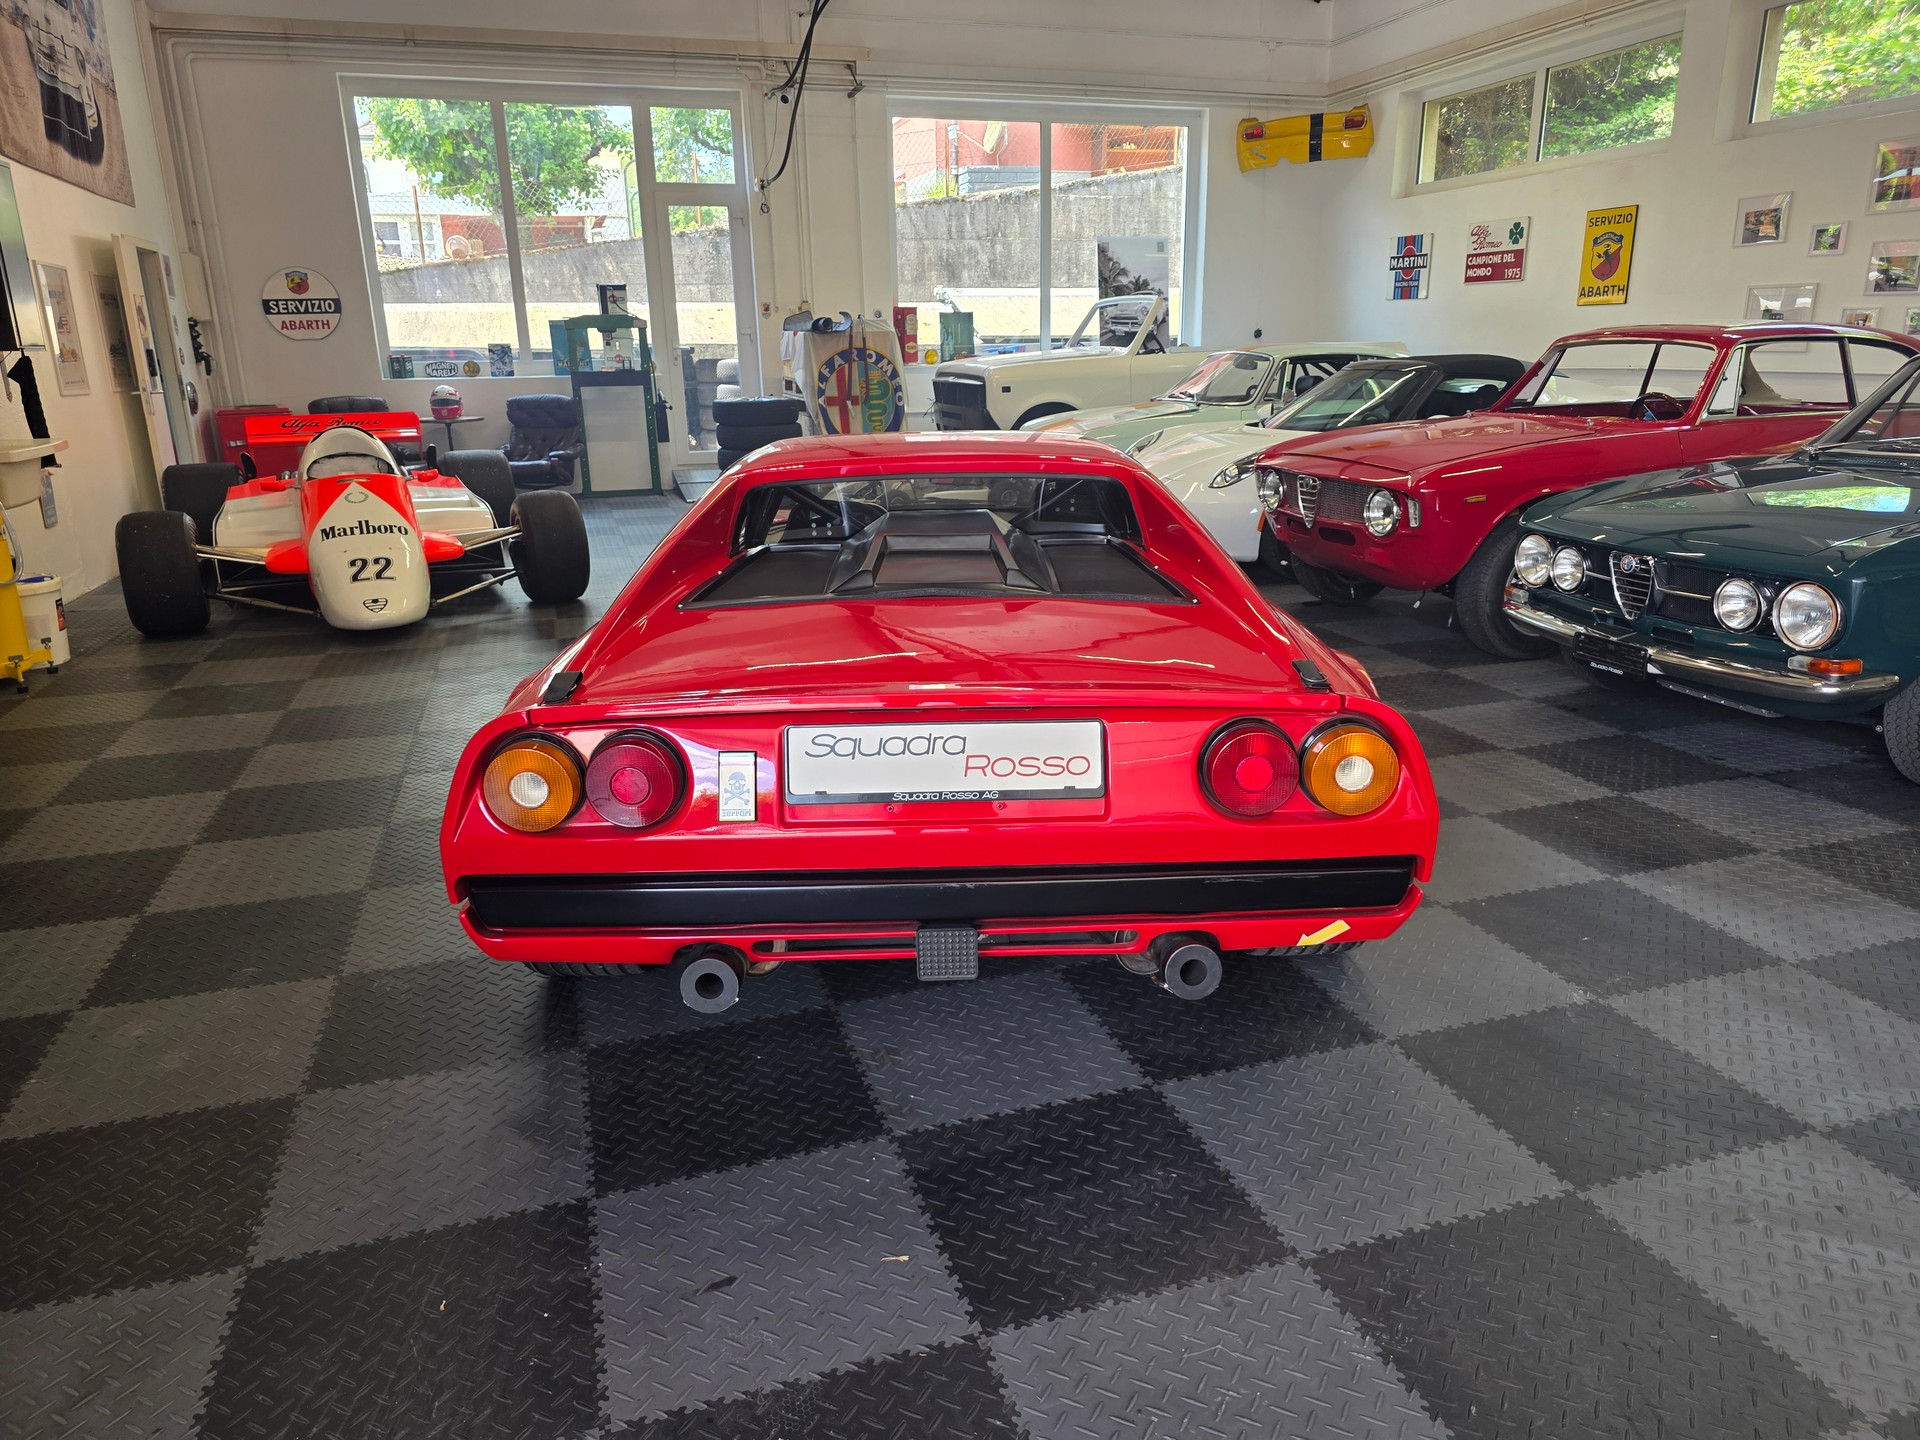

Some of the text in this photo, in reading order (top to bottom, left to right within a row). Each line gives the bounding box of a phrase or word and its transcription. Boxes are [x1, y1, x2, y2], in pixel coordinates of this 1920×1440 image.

[1588, 213, 1633, 228] SERVIZIO
[1470, 224, 1492, 238] Alfa
[1472, 237, 1503, 251] Romeo
[1390, 255, 1427, 269] MARTINI
[1467, 253, 1516, 266] CAMPIONE DEL
[1466, 267, 1492, 278] MONDO
[1504, 268, 1521, 279] 1975
[1579, 284, 1626, 298] ABARTH
[268, 300, 335, 313] SERVIZIO
[280, 319, 331, 331] ABARTH
[280, 416, 382, 432] Alfa Romeo
[319, 519, 409, 543] Marlboro
[348, 556, 396, 584] 22
[805, 733, 967, 760] Squadra
[892, 792, 940, 801] Squadra
[982, 790, 1000, 799] AG
